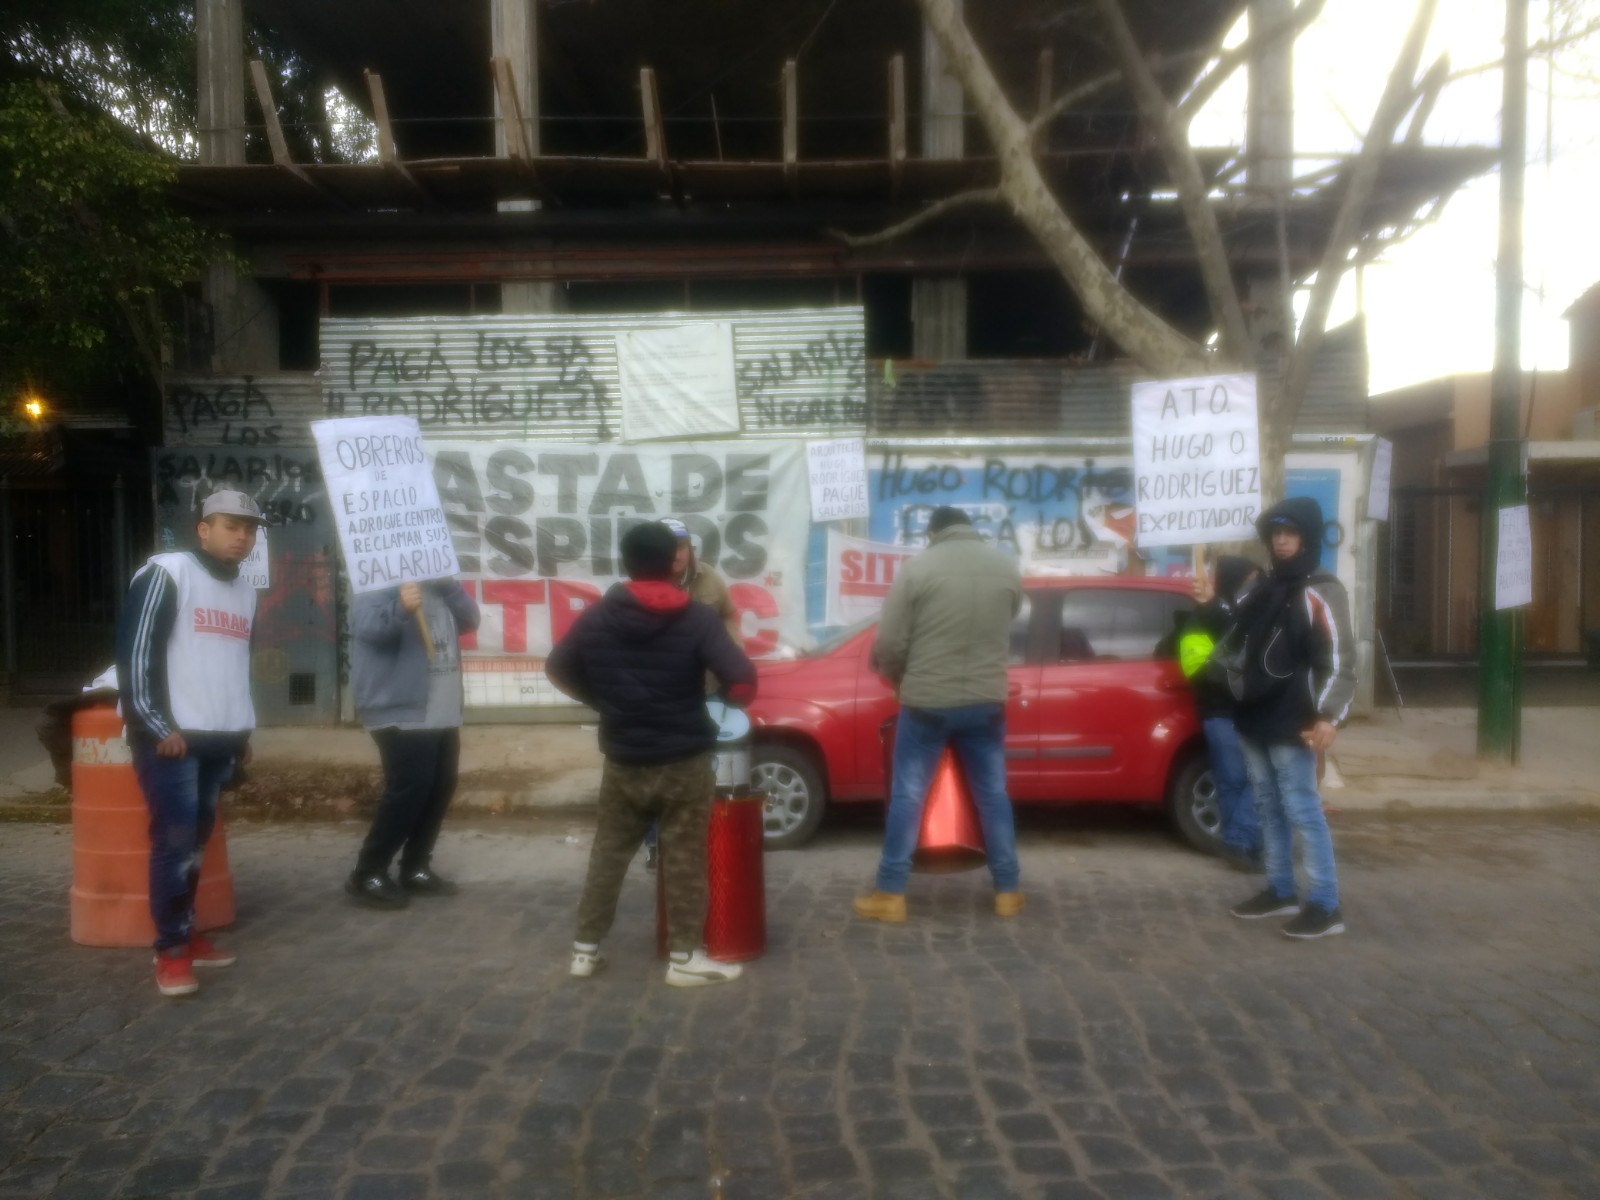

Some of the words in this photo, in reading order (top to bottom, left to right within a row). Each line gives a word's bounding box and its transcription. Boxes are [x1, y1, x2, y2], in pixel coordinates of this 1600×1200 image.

[221, 421, 283, 446] LOS
[1151, 432, 1214, 463] HUGO
[336, 434, 424, 471] OBREROS
[375, 470, 388, 481] DE
[434, 449, 657, 516] ASTA
[671, 453, 771, 512] DE
[1137, 466, 1259, 502] RODRIGUEZ
[342, 483, 418, 516] ESPACIO
[823, 484, 865, 503] PAGUE
[404, 507, 443, 528] CENTRO
[1138, 504, 1256, 534] EXPLOTADOR
[353, 530, 423, 554] RECLAMAN
[425, 526, 449, 544] SUS
[357, 544, 452, 587] SALARIOS
[194, 606, 250, 633] SITRAIC
